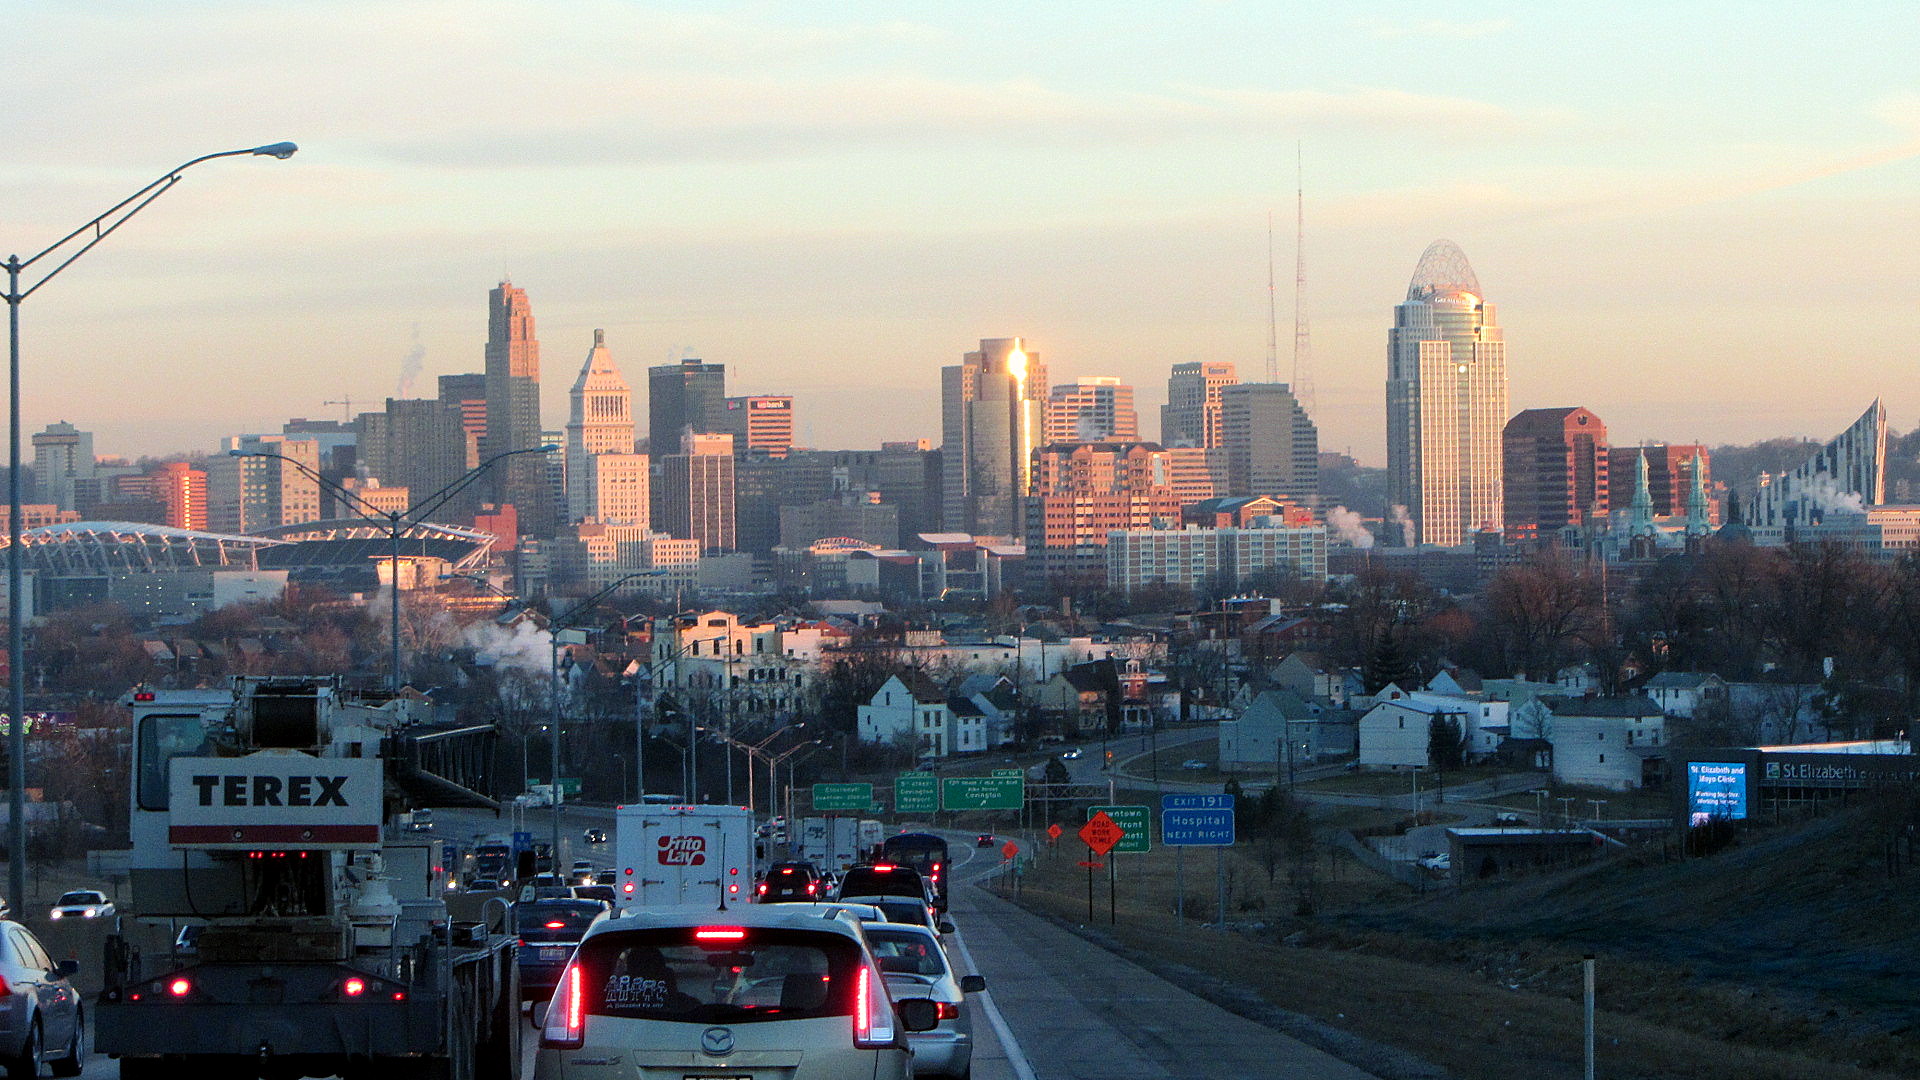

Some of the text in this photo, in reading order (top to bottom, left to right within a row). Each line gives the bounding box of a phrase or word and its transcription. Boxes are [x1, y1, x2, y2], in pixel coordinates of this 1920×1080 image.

[1800, 763, 1856, 779] Elizabeth
[1717, 775, 1736, 783] Clinic
[193, 776, 349, 806] TEREX
[1174, 797, 1223, 807] EXIT 191
[1172, 815, 1225, 827] Hospital
[1167, 831, 1230, 839] NEXT RIGHT
[666, 836, 703, 851] Frito
[666, 849, 699, 865] Lay
